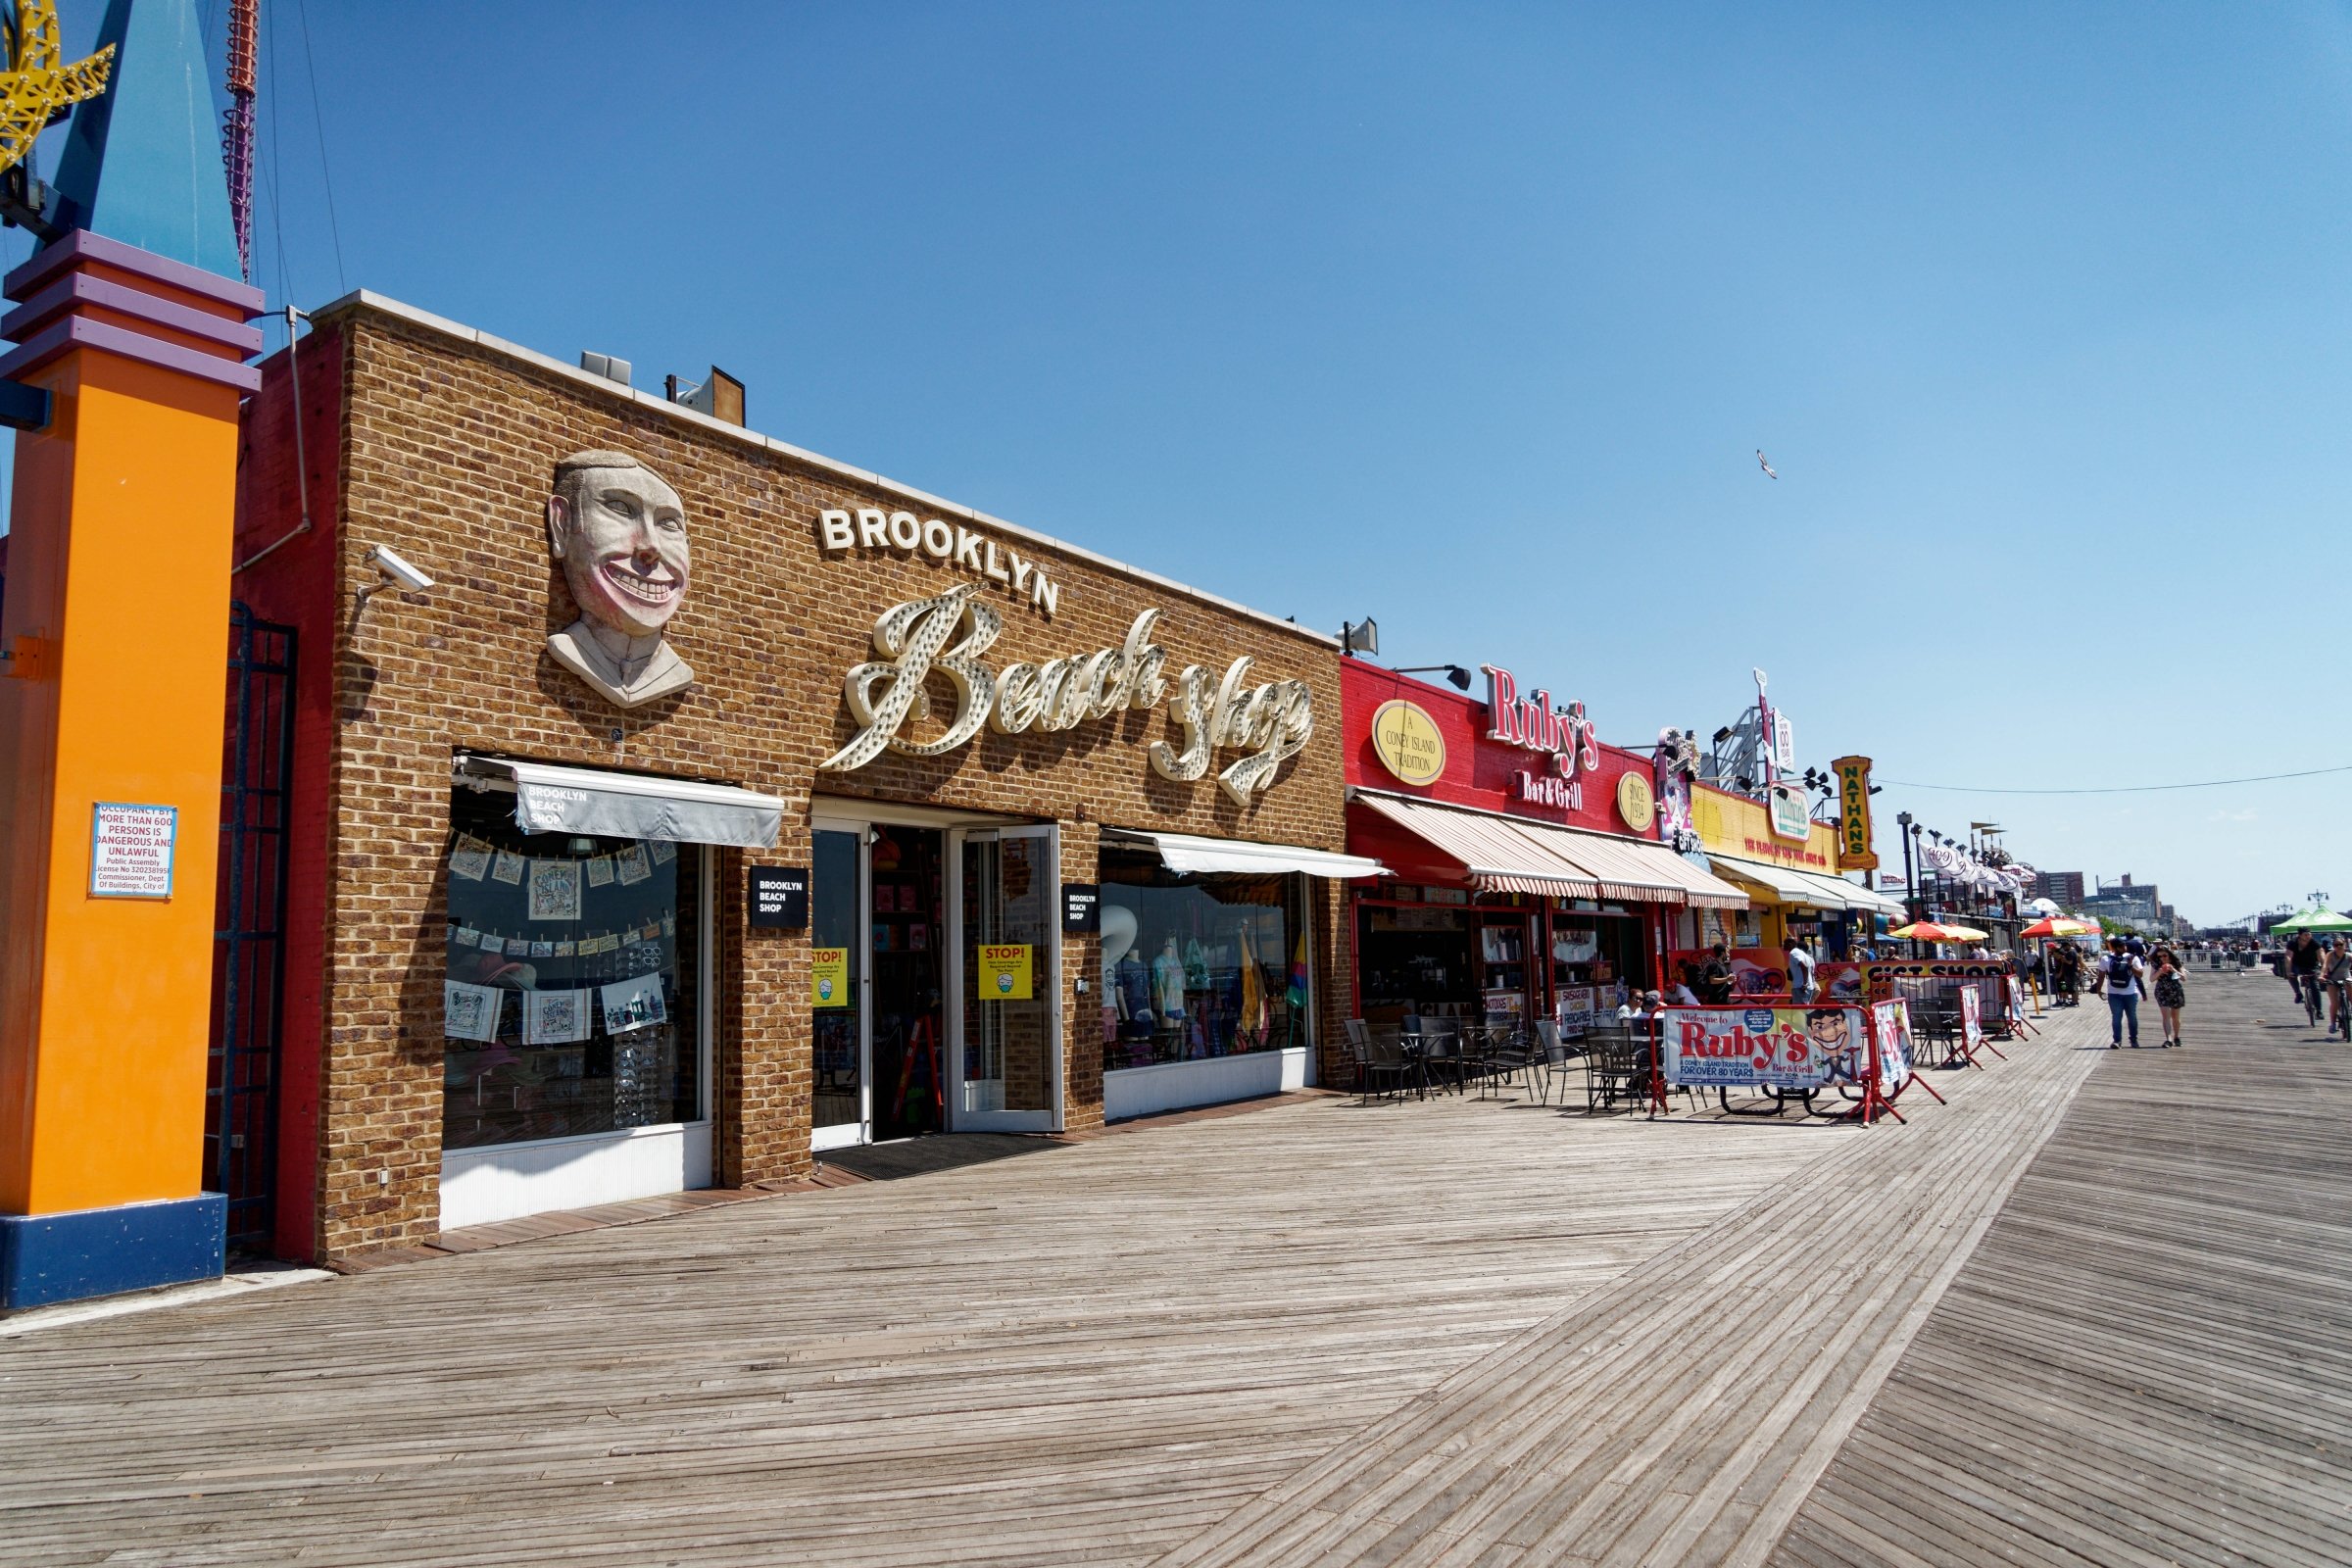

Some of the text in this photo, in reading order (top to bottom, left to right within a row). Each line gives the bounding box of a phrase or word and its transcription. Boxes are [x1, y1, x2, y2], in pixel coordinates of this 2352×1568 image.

[818, 508, 1059, 616] BROOKLYN
[818, 581, 1314, 808] Beach Shop
[1407, 715, 1413, 729] A
[1481, 662, 1598, 778] Ruby's
[1386, 730, 1436, 755] CONEY ISLAND
[1394, 752, 1431, 771] TRADITION
[528, 786, 587, 802] BROOKLYN
[1629, 783, 1644, 803] SINCE
[529, 800, 565, 812] BEACH
[1631, 803, 1644, 819] 1934
[1843, 765, 1864, 855] NATHANS
[98, 814, 172, 826] MORE THAN 600
[530, 813, 561, 825] SHOP
[109, 825, 151, 836] PERSONS
[95, 835, 173, 848] DANGEROUS AND
[1679, 835, 1690, 852] GIFT
[108, 847, 159, 858] UNLAWFUL
[98, 873, 146, 882] Commissioner,
[108, 881, 142, 890] Buildings,
[760, 880, 803, 891] BROOKLYN
[760, 892, 786, 902] BEACH
[760, 903, 782, 912] SHOP
[811, 951, 842, 963] STOP!
[986, 947, 1025, 959] STOP!
[1681, 1012, 1728, 1024] Welcome to
[1676, 1021, 1808, 1070] Ruby's
[1680, 1066, 1695, 1075] FOR
[1696, 1066, 1717, 1076] OVER
[1728, 1067, 1754, 1078] YEARS
[1772, 1063, 1787, 1073] Bar
[1793, 1064, 1813, 1074] Grill
